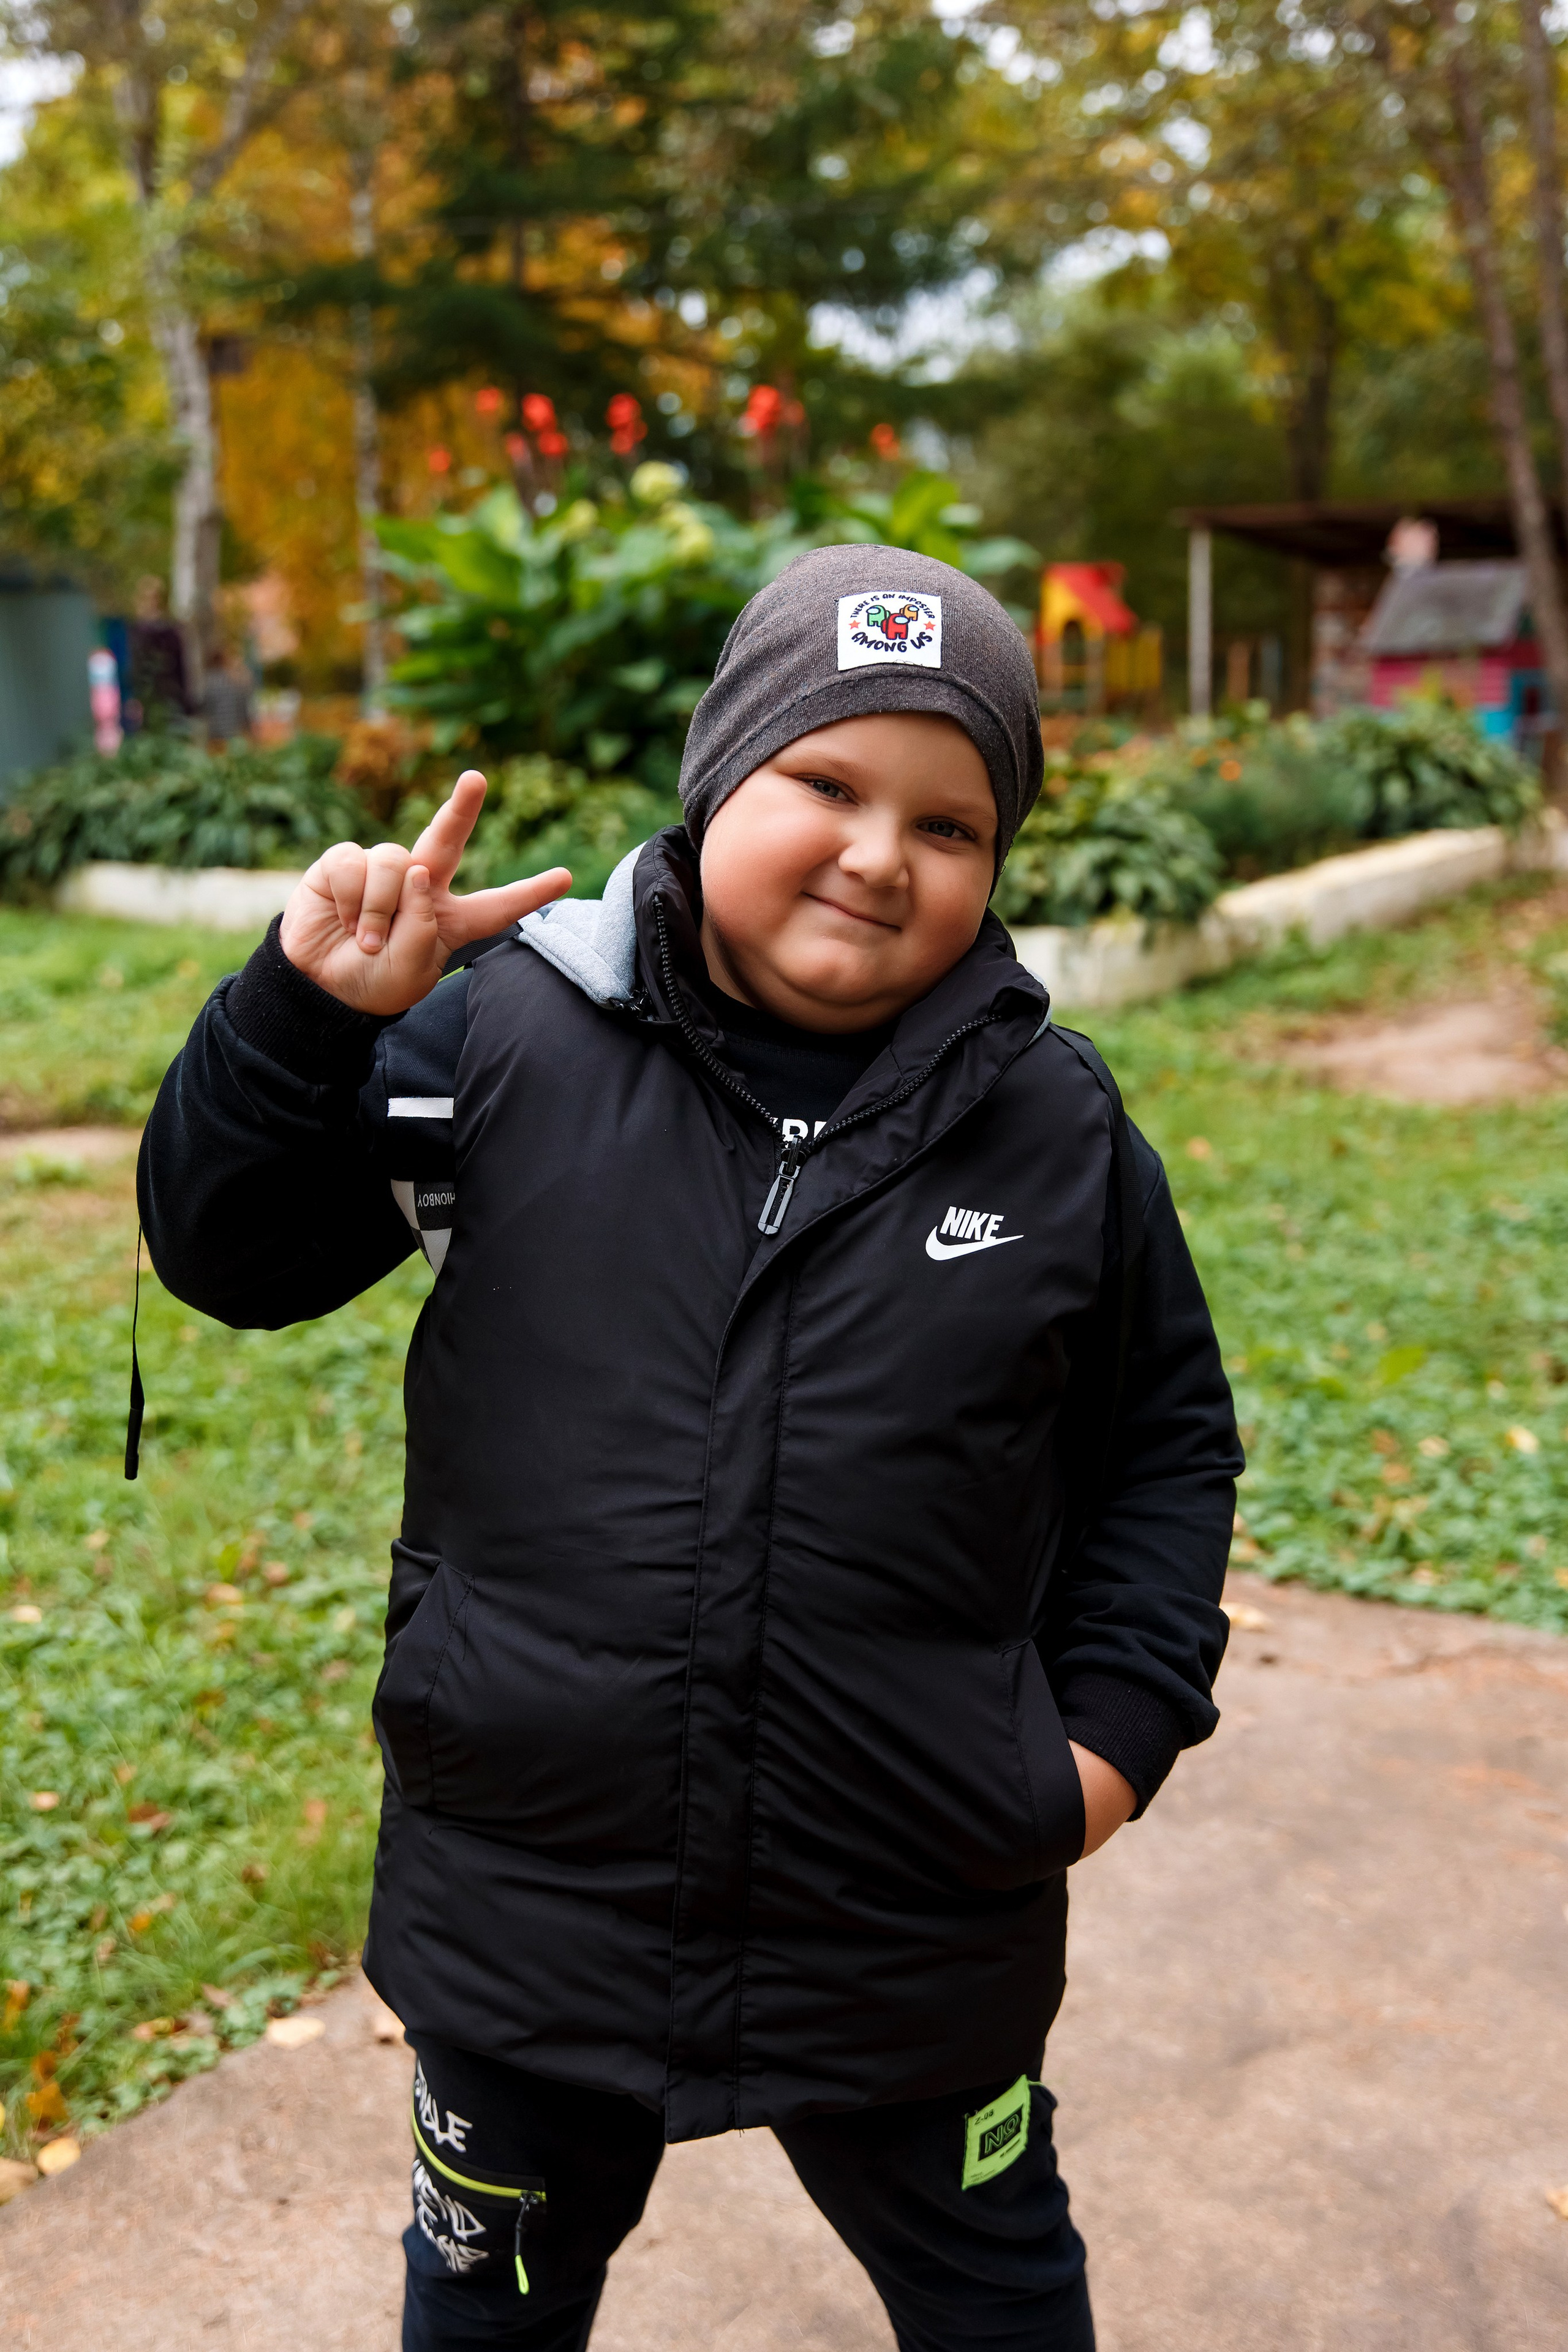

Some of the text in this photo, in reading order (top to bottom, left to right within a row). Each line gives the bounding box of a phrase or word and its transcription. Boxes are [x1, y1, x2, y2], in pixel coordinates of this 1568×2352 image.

[850, 600, 870, 618] THERE
[898, 595, 935, 619] IMPOSTER
[851, 631, 933, 652] AMONG US
[940, 1205, 1005, 1241] NIKE
